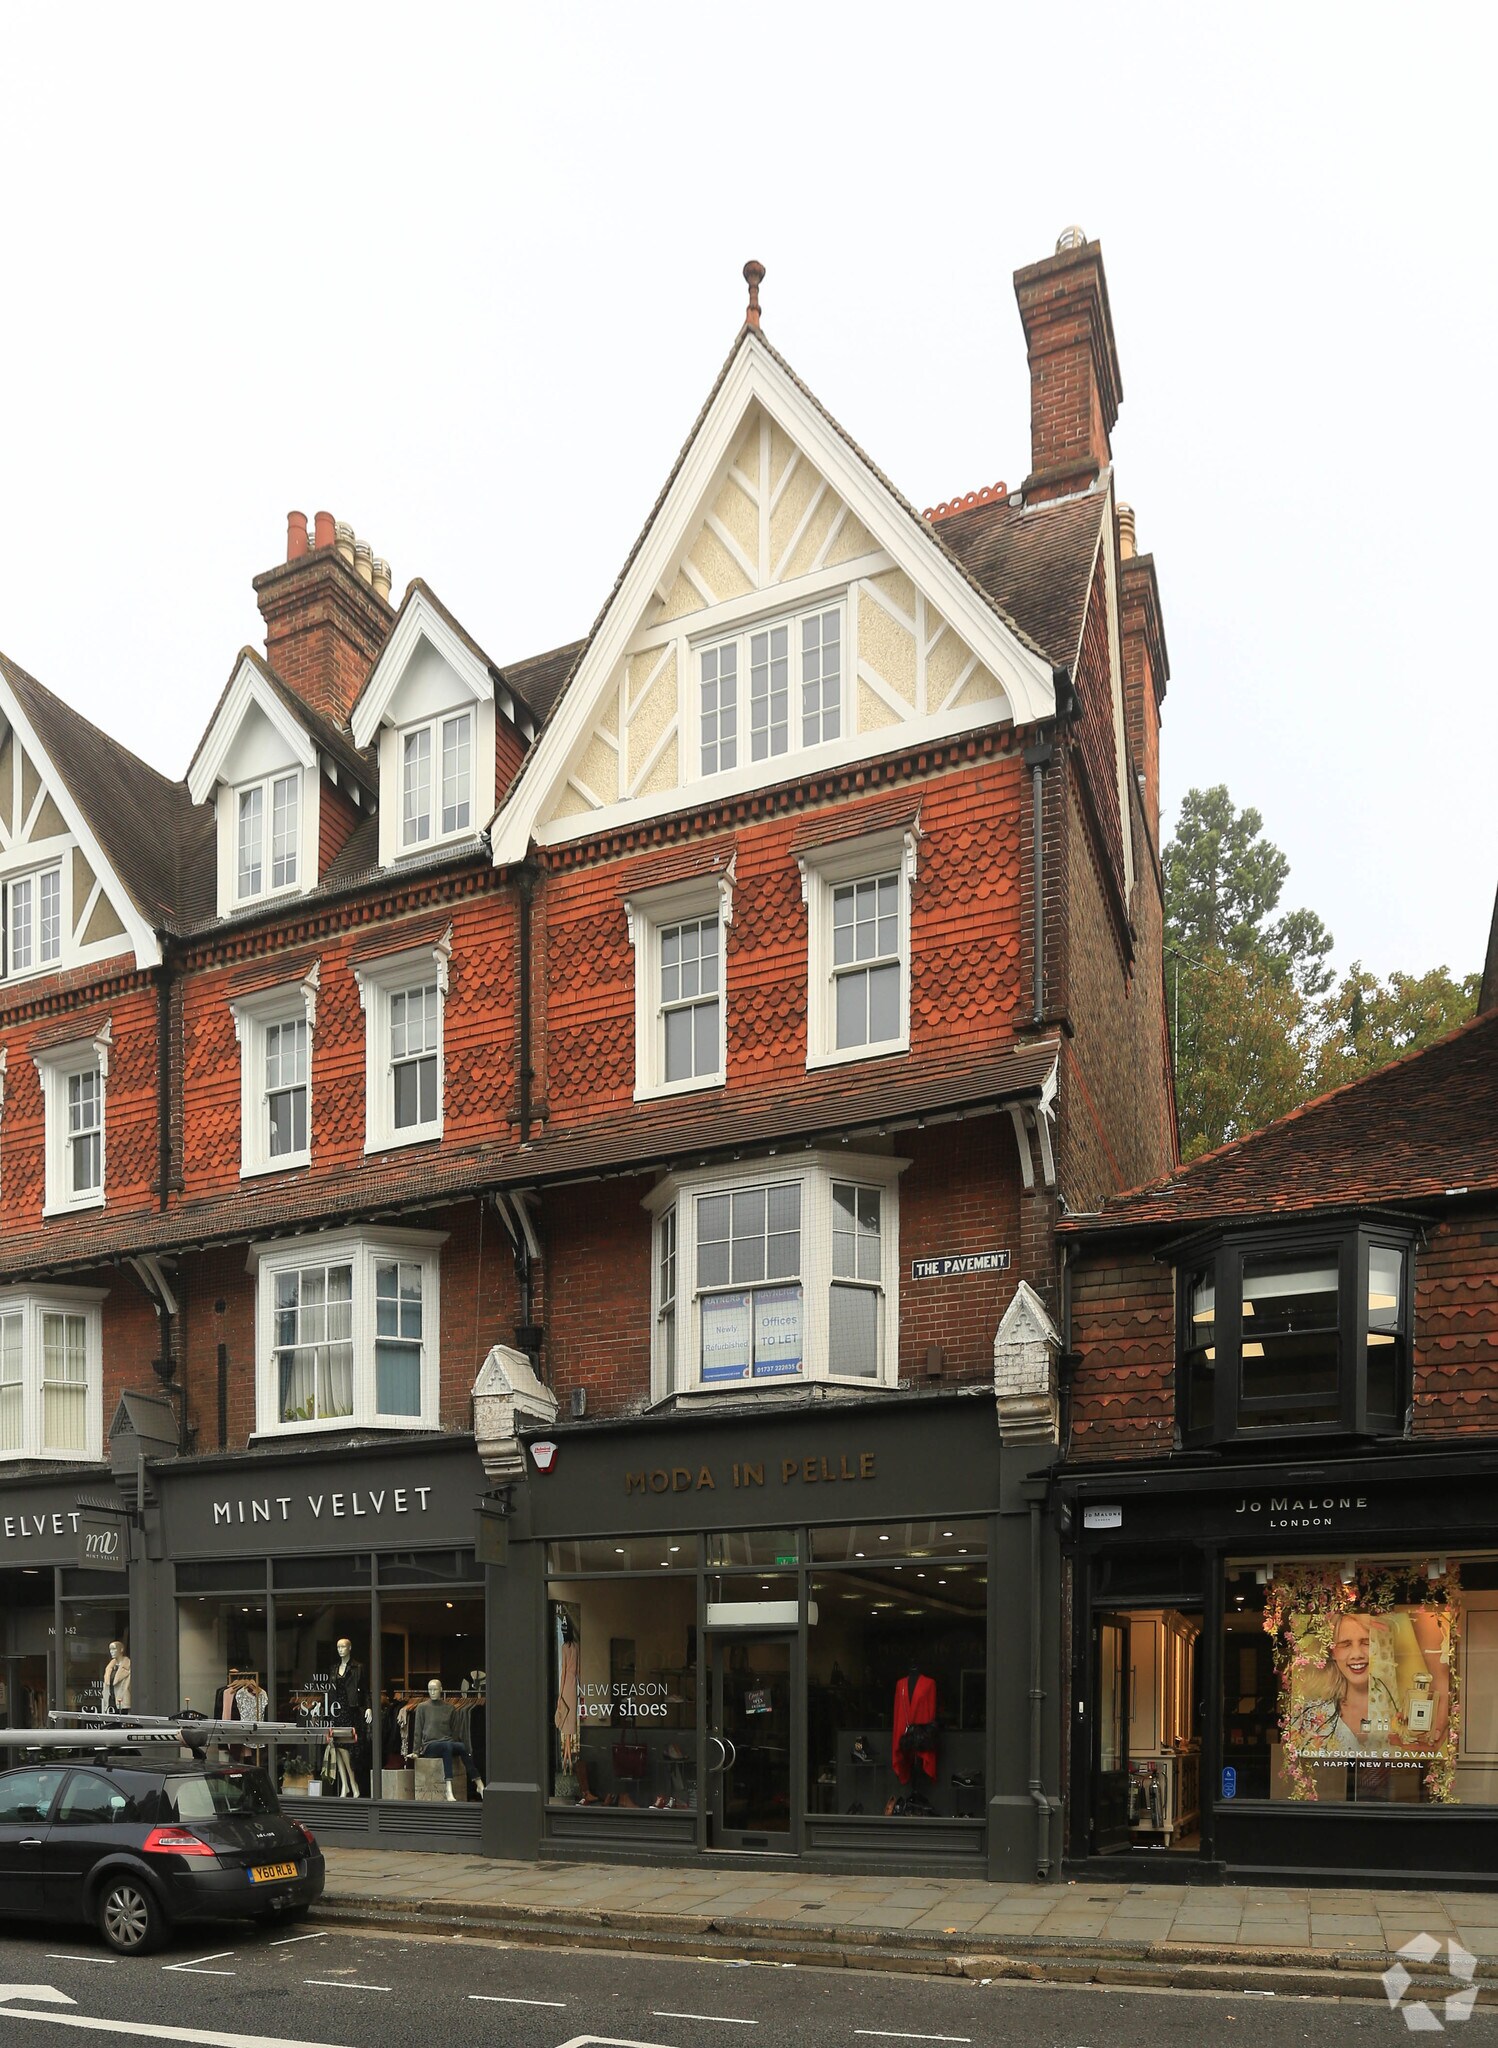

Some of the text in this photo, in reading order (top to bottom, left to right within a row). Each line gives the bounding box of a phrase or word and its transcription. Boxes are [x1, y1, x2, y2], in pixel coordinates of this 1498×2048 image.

[916, 1254, 1007, 1276] THE PAVEMENT
[762, 1316, 798, 1327] Offices
[716, 1325, 737, 1334] Newly
[705, 1341, 748, 1352] Refurbished
[761, 1334, 798, 1346] TO LET
[625, 1453, 876, 1495] MODA IN PELLE
[213, 1486, 432, 1524] MINT VELVET
[1270, 1518, 1332, 1528] LONDON
[304, 1683, 337, 1691] SEASON
[577, 1683, 668, 1696] NEW SEASON
[300, 1692, 341, 1718] sale
[578, 1696, 668, 1716] new shoes
[256, 1864, 293, 1879] Y60 RLB
